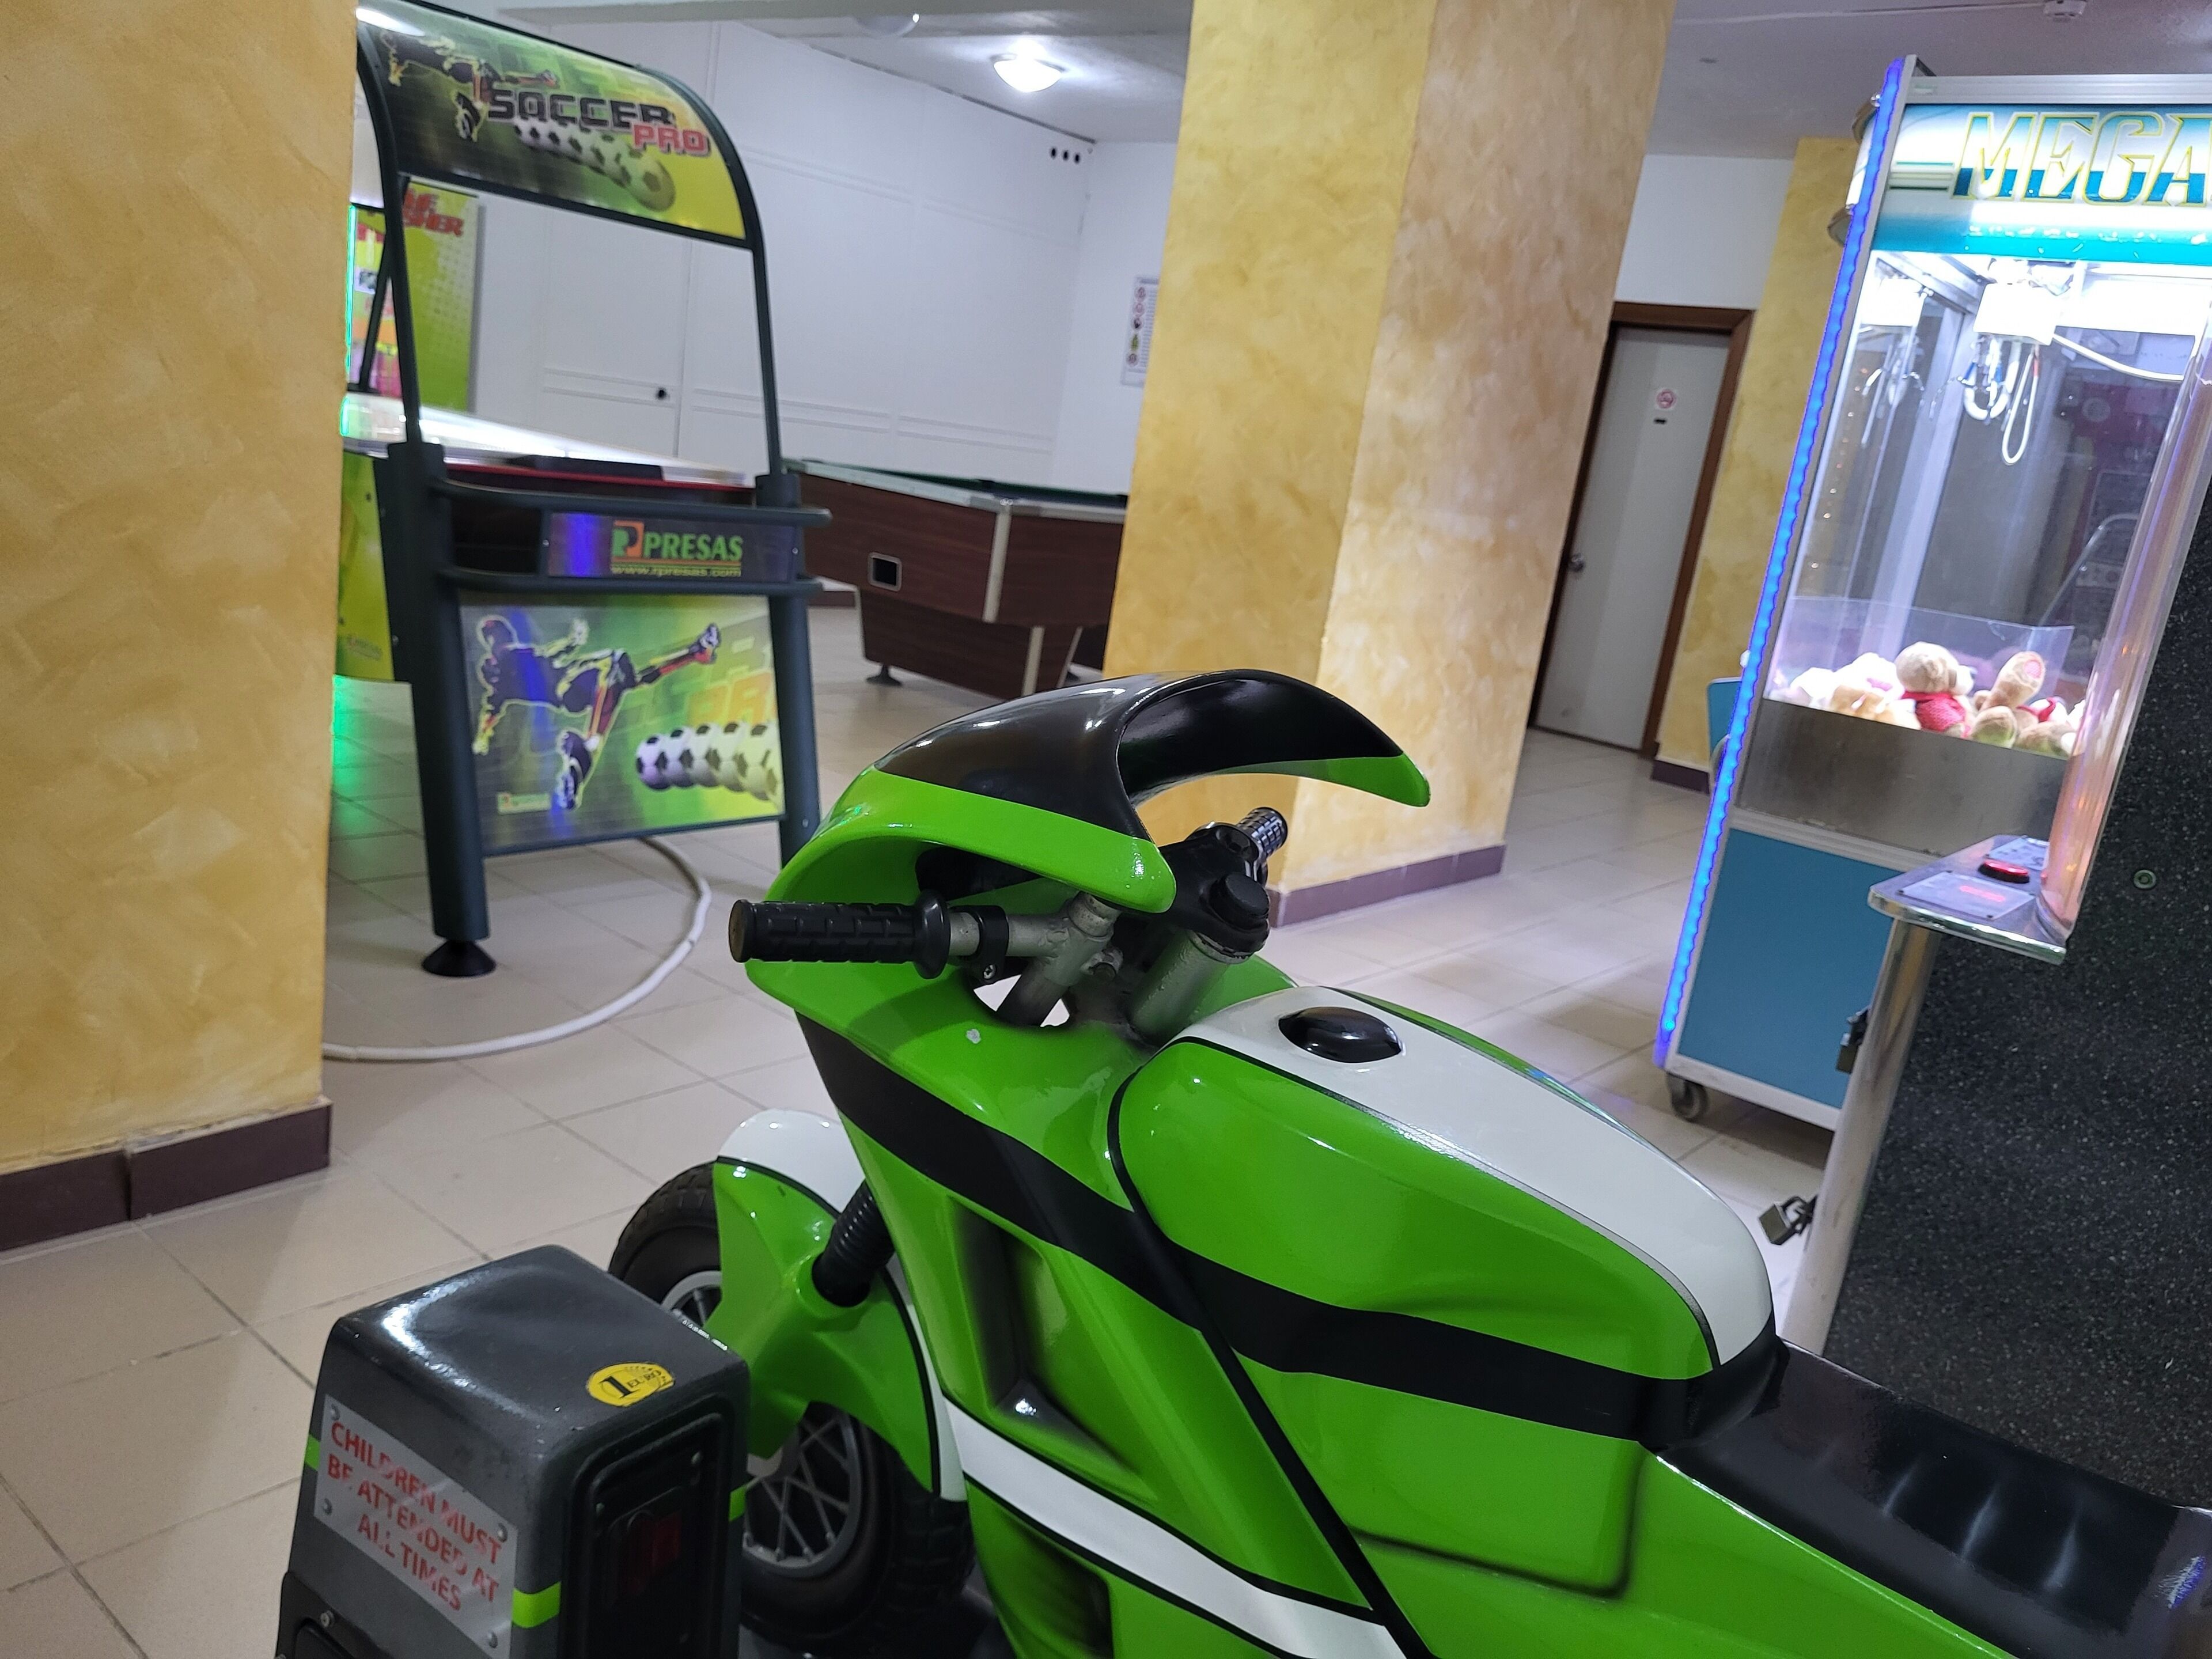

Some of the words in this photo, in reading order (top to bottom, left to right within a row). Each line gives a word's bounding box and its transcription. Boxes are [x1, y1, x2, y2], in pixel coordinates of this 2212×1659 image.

[487, 88, 676, 130] SOCCER
[633, 123, 710, 156] PRO
[1951, 112, 2212, 207] MEGA
[642, 531, 744, 562] PRESAS
[627, 1369, 662, 1388] EURO
[331, 1421, 436, 1514] CHILDREN
[441, 1499, 502, 1565] MUST
[327, 1453, 353, 1480] BE
[357, 1479, 468, 1576] ATTENDED
[472, 1566, 499, 1603] AT
[400, 1541, 461, 1611] TIMES
